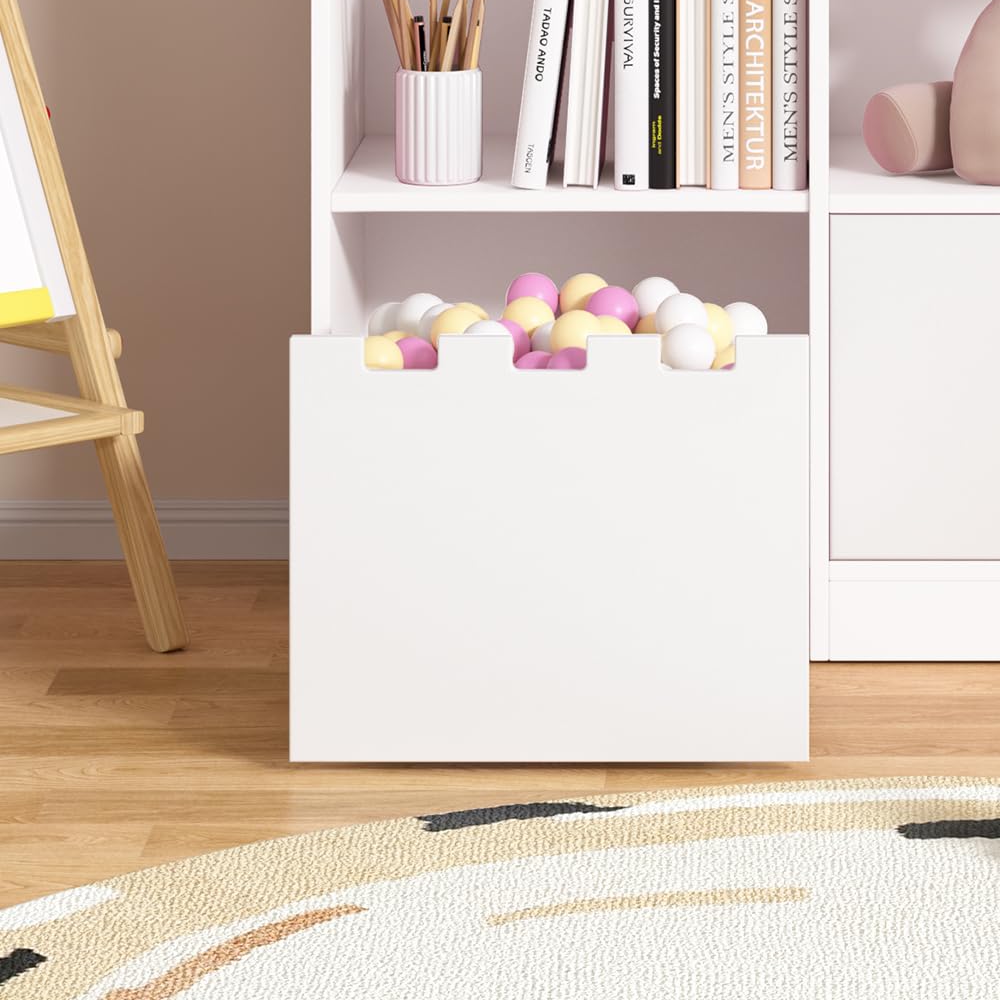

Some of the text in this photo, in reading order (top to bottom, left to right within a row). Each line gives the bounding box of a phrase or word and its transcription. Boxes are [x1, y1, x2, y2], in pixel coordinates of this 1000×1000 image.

[653, 5, 661, 21] and
[653, 21, 661, 58] Security
[535, 7, 552, 82] TADAO ANDO
[653, 58, 661, 68] of
[722, 11, 735, 85] STYLE
[784, 11, 798, 85] STYLE
[653, 69, 661, 99] Spaces
[722, 91, 735, 163] MEN'S
[784, 91, 798, 163] MEN'S
[524, 144, 534, 174] TASCEN
